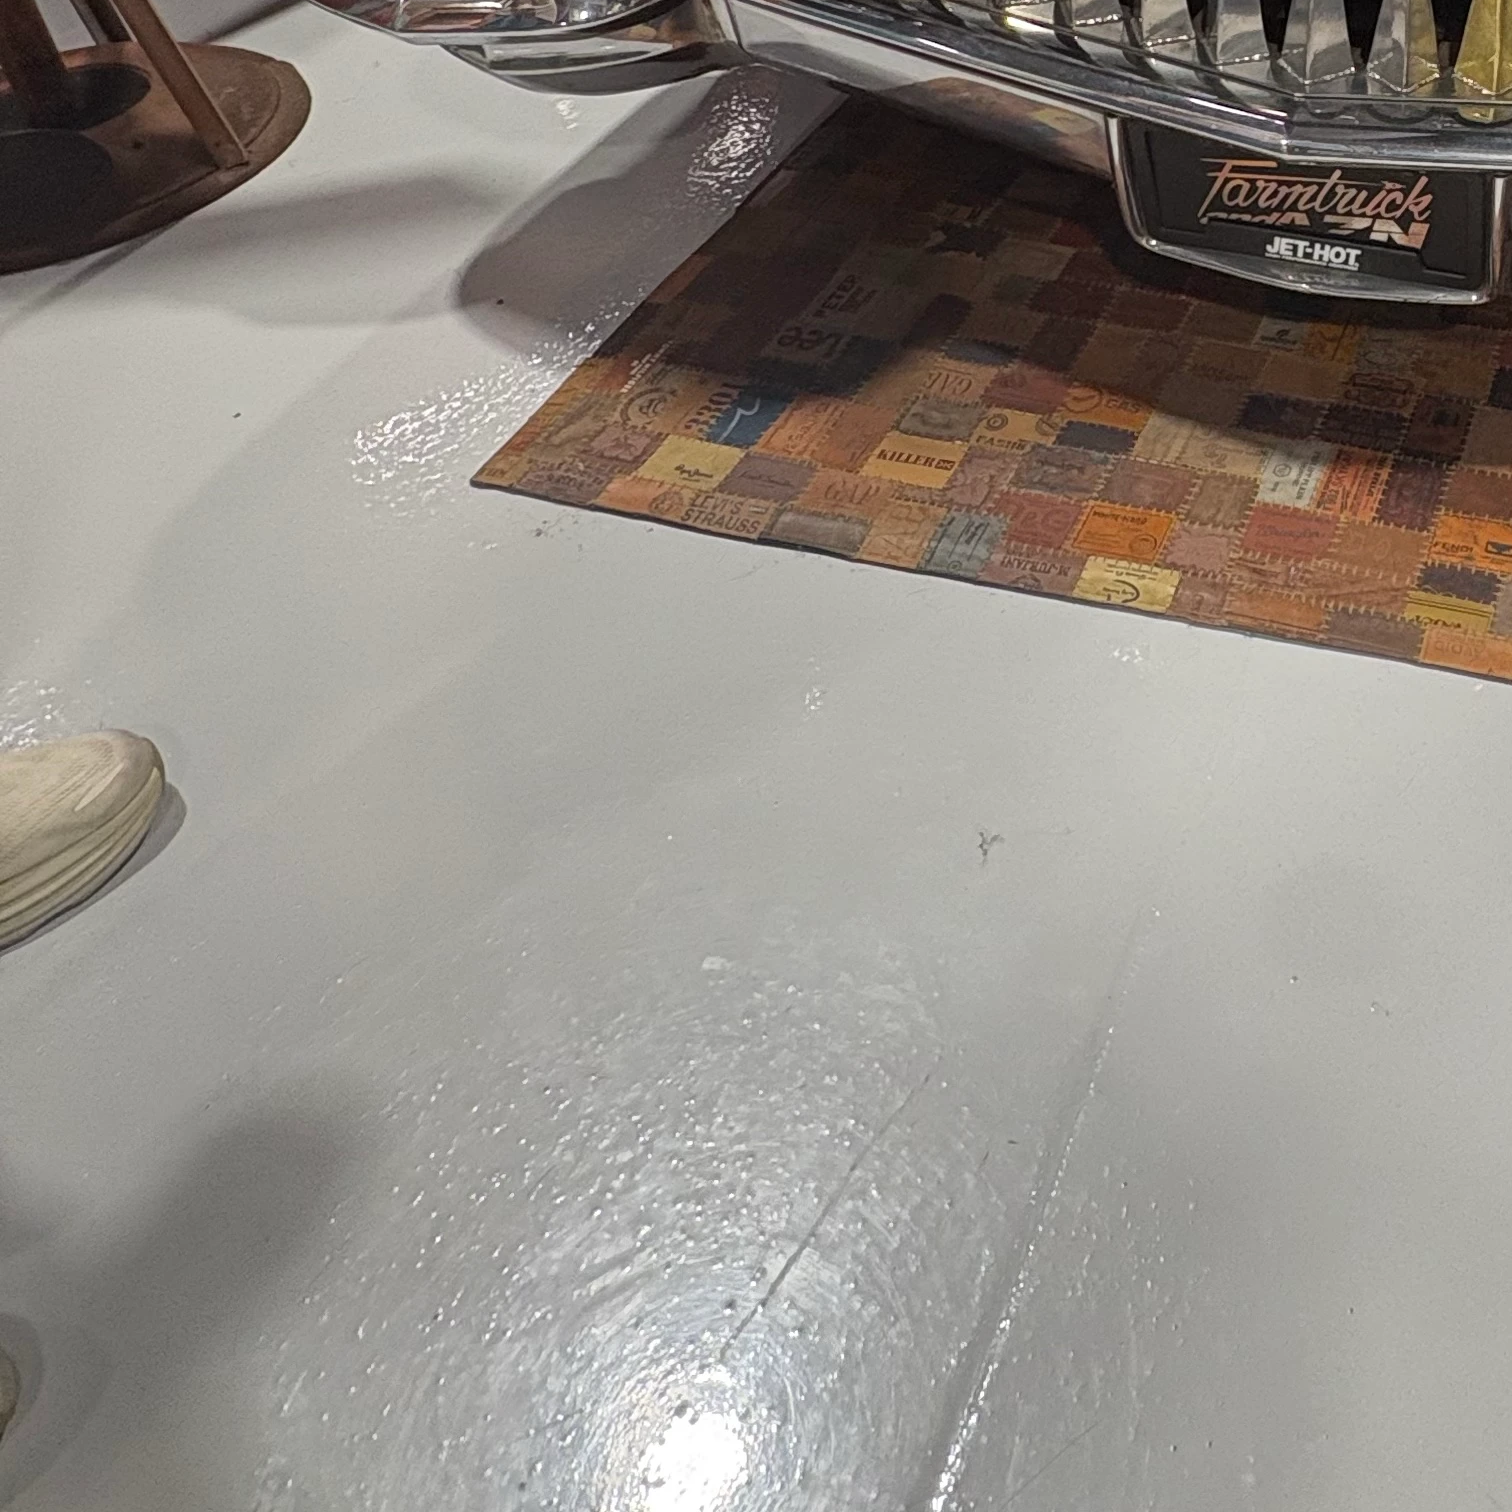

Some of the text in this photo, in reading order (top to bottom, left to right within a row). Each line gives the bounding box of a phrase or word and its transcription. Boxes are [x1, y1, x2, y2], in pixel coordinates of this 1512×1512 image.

[1200, 158, 1434, 221] Farmtruck
[1265, 236, 1362, 266] JET-HOT
[876, 448, 935, 469] KILLER
[689, 491, 744, 515] LEVI'S
[680, 508, 761, 536] STRAUSS
